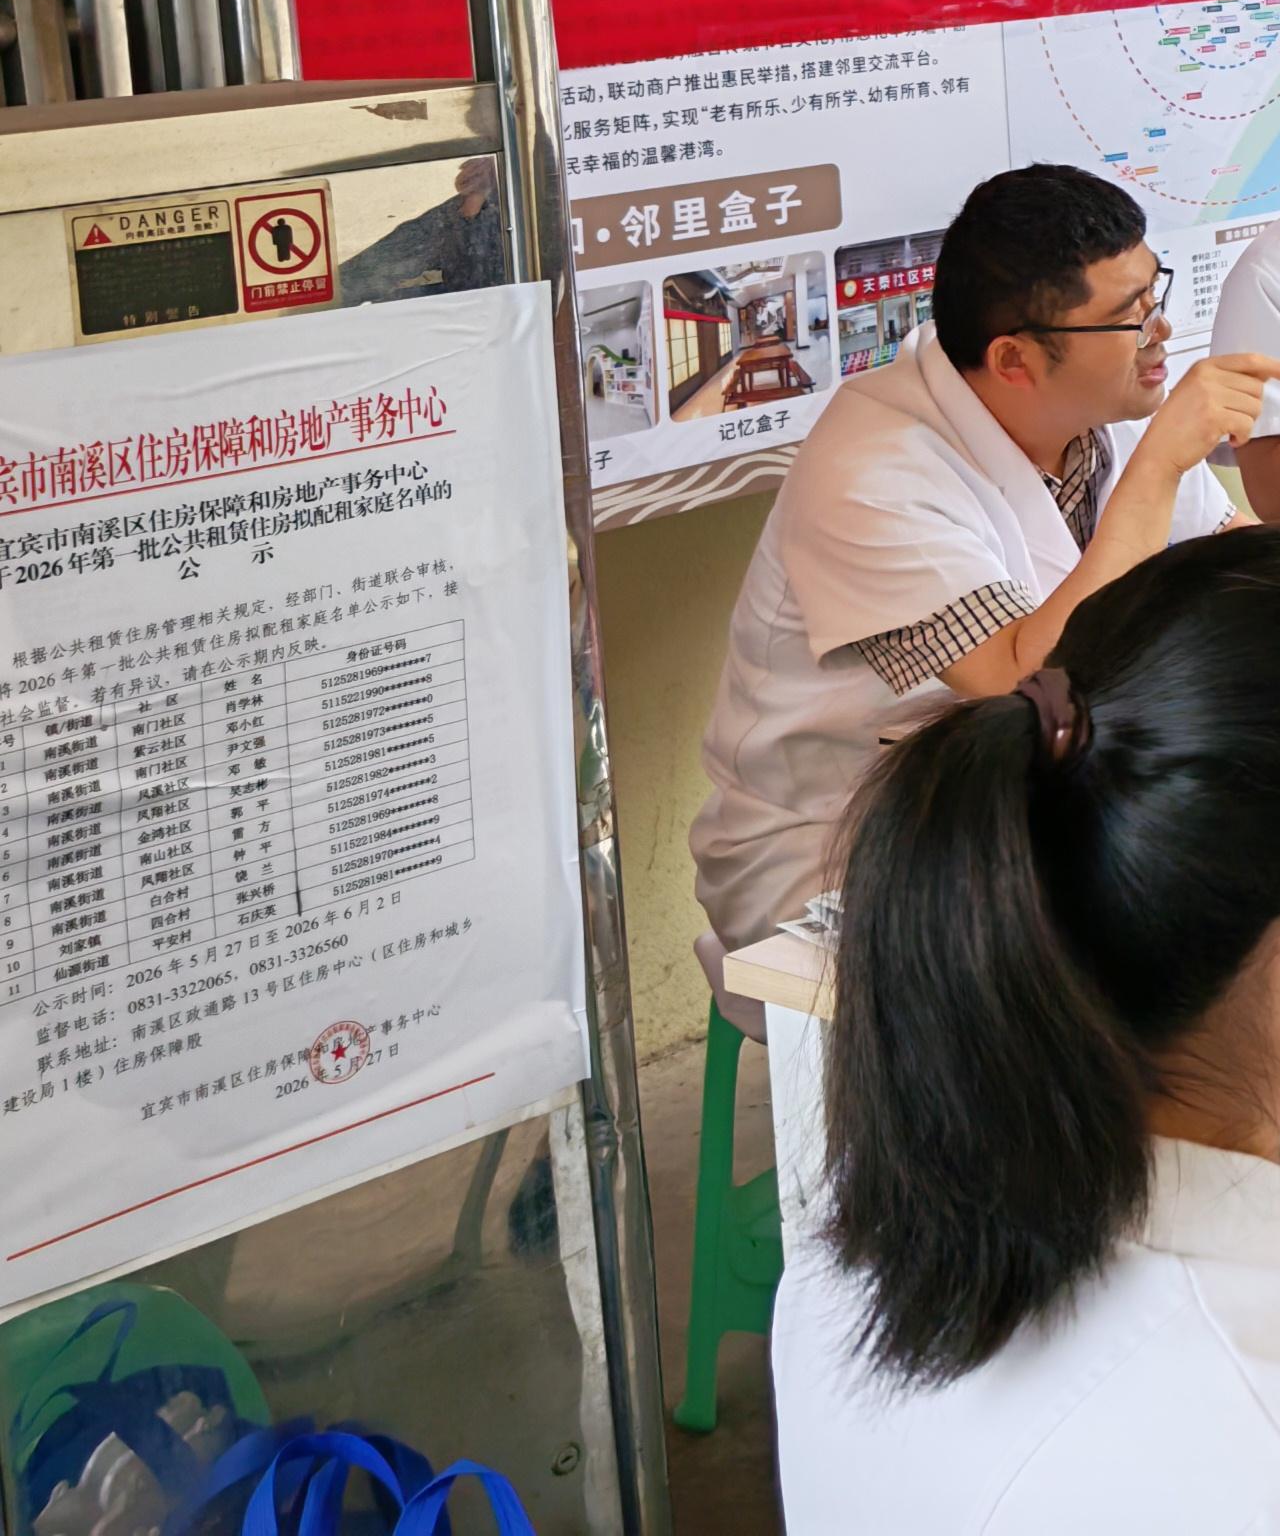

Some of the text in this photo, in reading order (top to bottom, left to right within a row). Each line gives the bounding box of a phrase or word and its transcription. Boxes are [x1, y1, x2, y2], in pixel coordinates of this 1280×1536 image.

[120, 206, 220, 231] DANGER
[251, 278, 327, 300] 门前禁止停留
[718, 409, 791, 442] 记忆盒子
[346, 638, 407, 664] 身份证号码
[44, 736, 98, 761] 南溪街道
[44, 757, 99, 783] 南溪街道
[48, 779, 102, 806] 南溪街道
[47, 801, 102, 827] 南溪街道
[47, 822, 102, 849] 南溪街道
[47, 843, 103, 870] 南溪街道
[48, 865, 104, 892] 南溪街道
[49, 888, 105, 915] 南溪街道
[51, 910, 107, 937] 南溪街道
[59, 934, 102, 957] 刘家镇
[53, 954, 110, 982] 仙源街道
